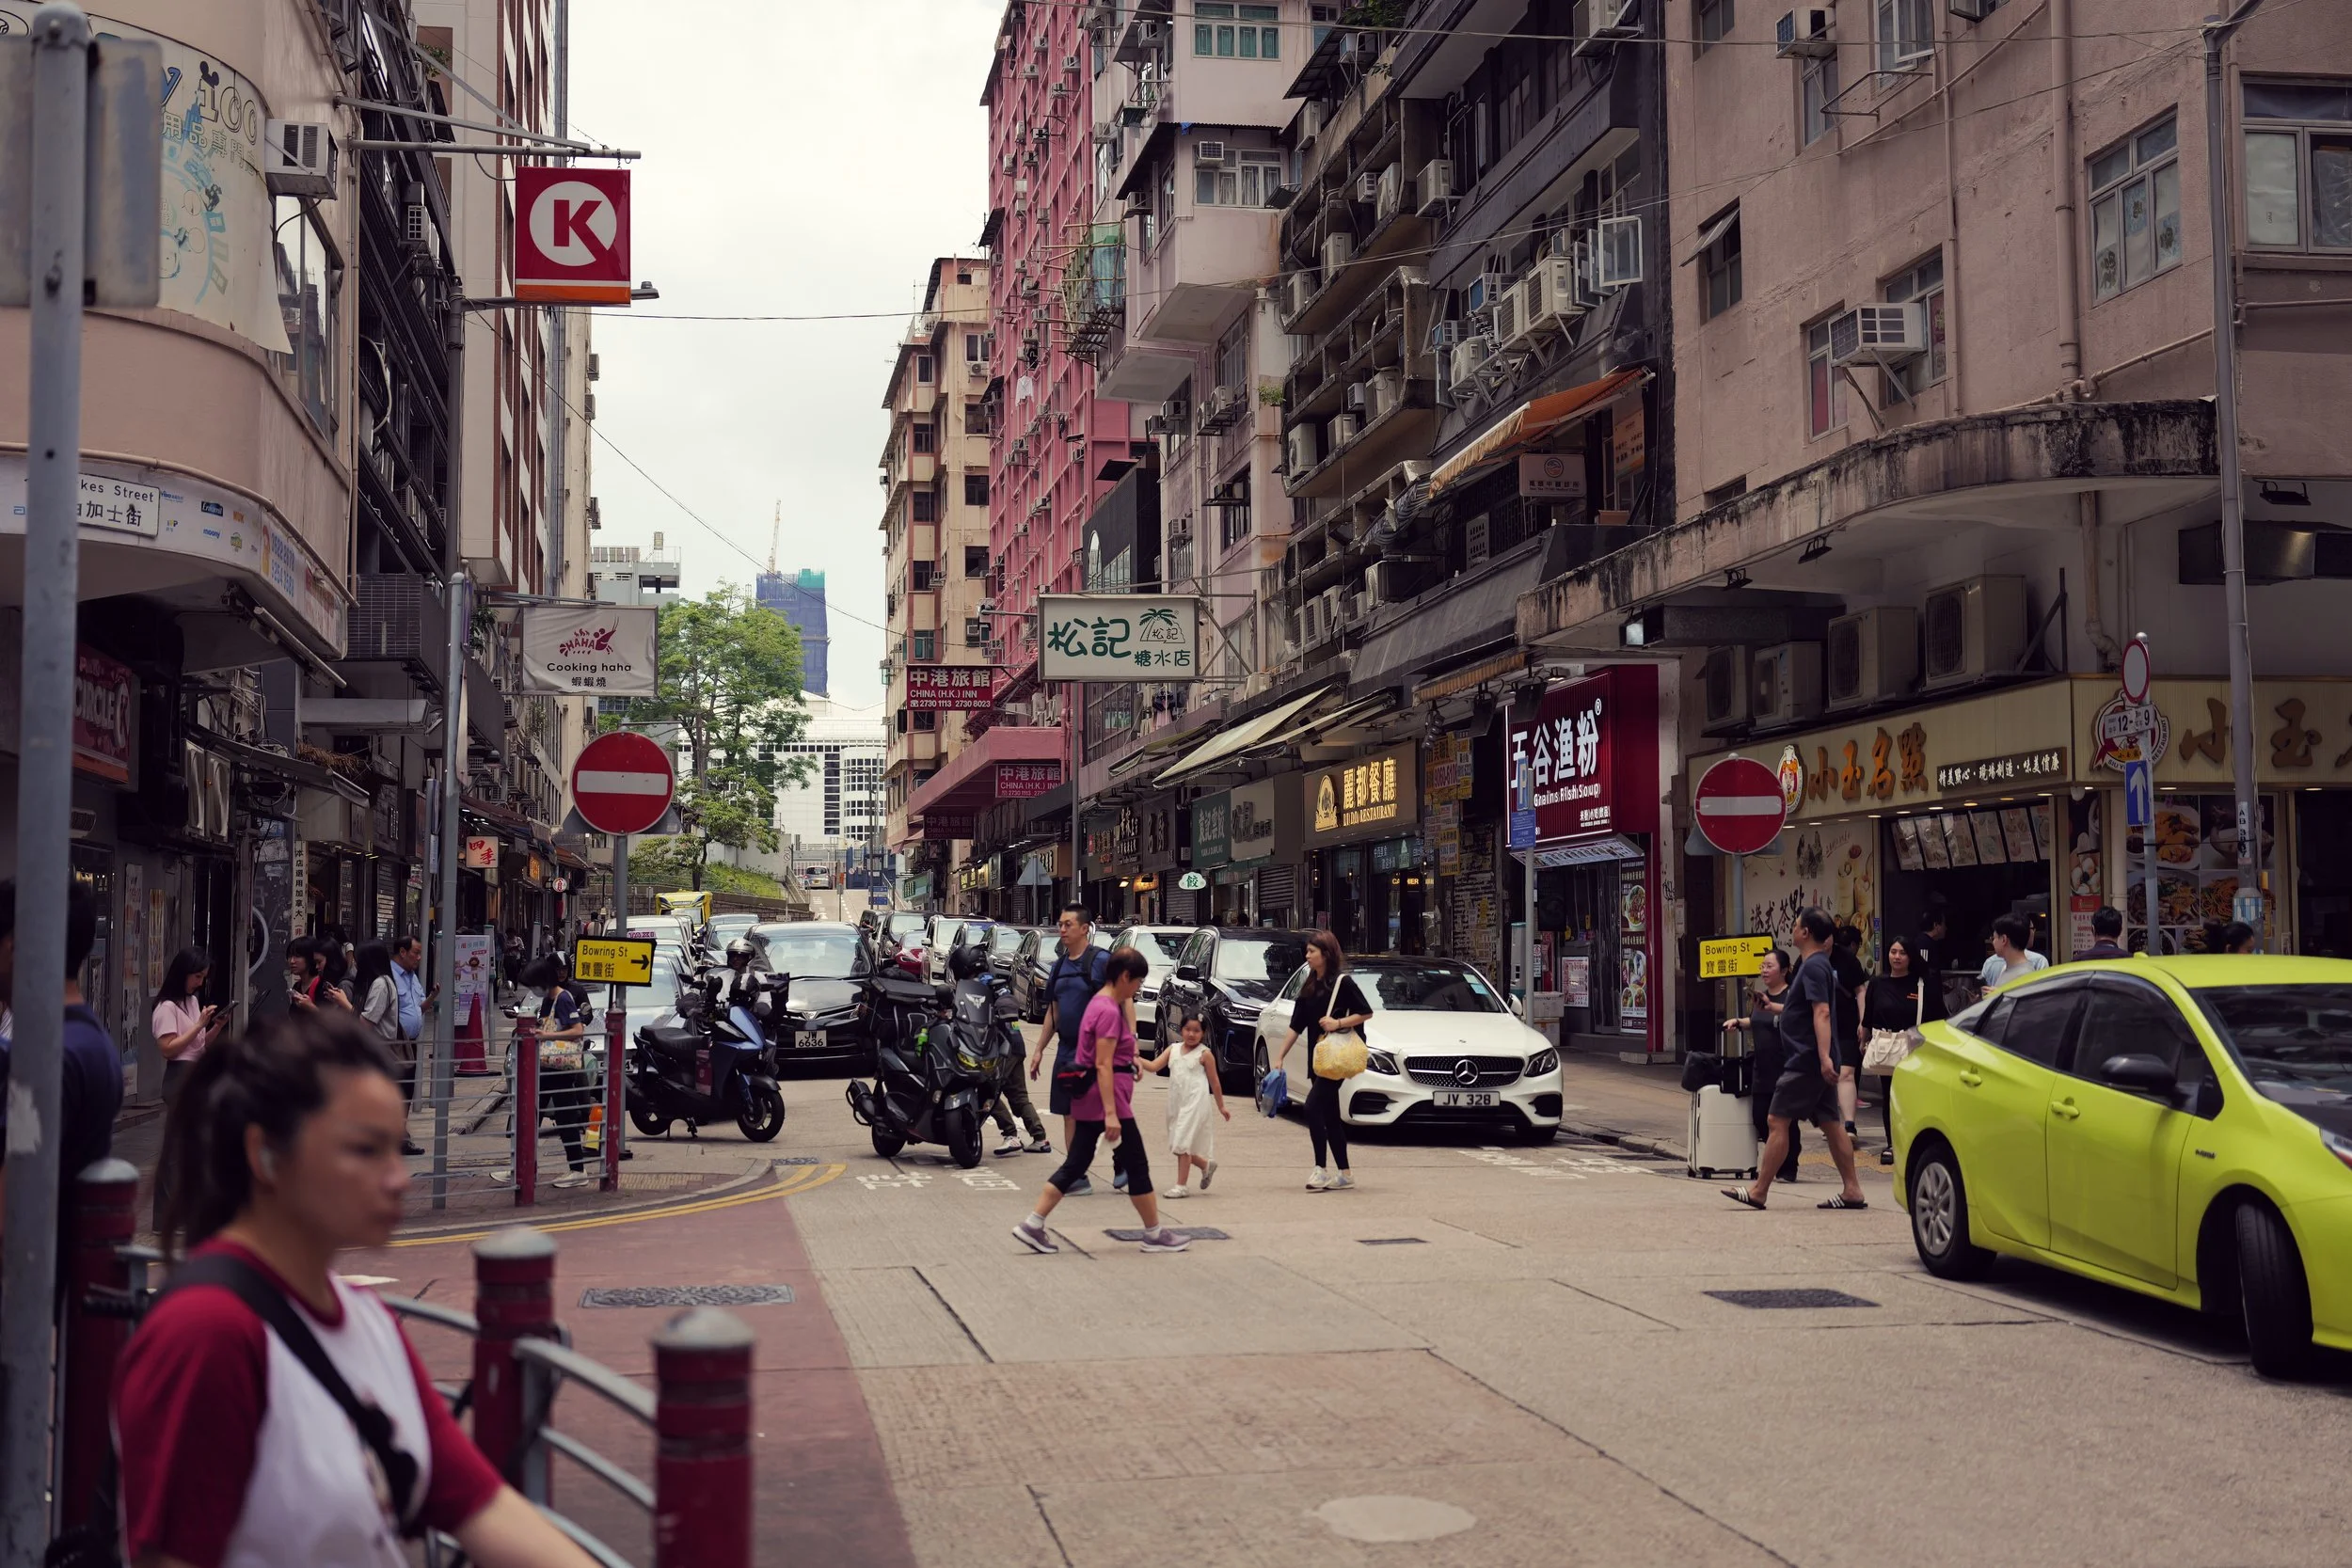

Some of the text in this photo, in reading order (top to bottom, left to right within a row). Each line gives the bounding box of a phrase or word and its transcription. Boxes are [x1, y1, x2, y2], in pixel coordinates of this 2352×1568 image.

[80, 480, 104, 493] kes
[114, 486, 154, 503] Street
[1047, 616, 1132, 658] 松記
[1152, 627, 1179, 640] 松記
[565, 638, 596, 651] HAHA
[1135, 650, 1191, 667] 糖水店
[547, 662, 631, 673] Cooking haha
[571, 676, 607, 688] 蝦蝦燒
[910, 669, 991, 688] 中港旅館
[938, 689, 961, 699] (H.K.)
[1000, 766, 1061, 781] 中港旅館
[1343, 757, 1397, 809] 麗都餐廳
[1579, 784, 1601, 799] Soup
[469, 840, 496, 865] 四季
[1186, 875, 1199, 888] 餃
[582, 944, 628, 958] Bowring St
[1705, 942, 1750, 956] Bowring St
[581, 961, 614, 978] 寶靈街
[1706, 958, 1738, 974] 寶靈街
[804, 1030, 818, 1038] JW
[798, 1038, 824, 1048] 6636
[1442, 1094, 1491, 1105] JV 328
